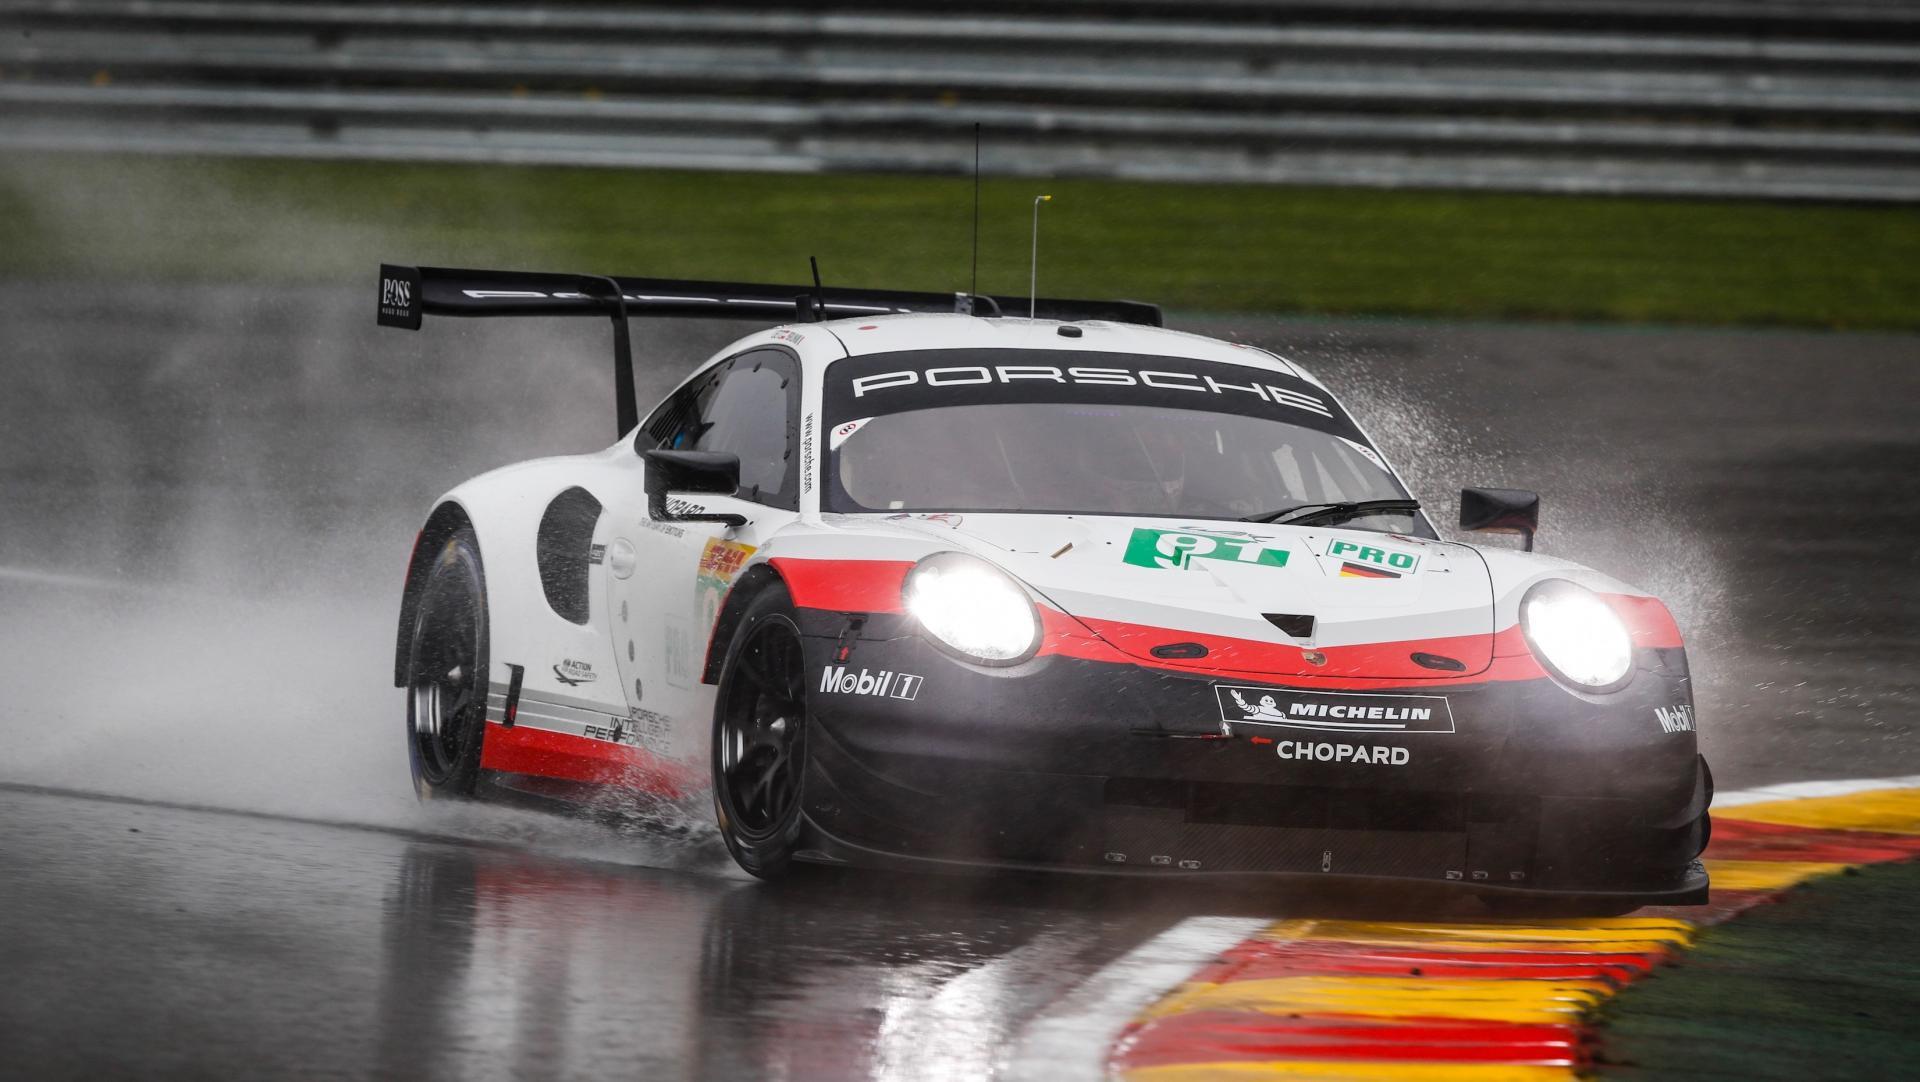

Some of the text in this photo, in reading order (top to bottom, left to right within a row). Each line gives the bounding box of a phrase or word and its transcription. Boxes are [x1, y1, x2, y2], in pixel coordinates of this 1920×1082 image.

[383, 278, 410, 307] BOSS
[852, 366, 1335, 418] PORSCHE
[802, 412, 814, 495] www.porsche.com
[1332, 541, 1414, 569] PRO
[819, 666, 893, 697] Mobil
[1289, 702, 1431, 721] MICHELIN
[1276, 740, 1410, 765] CHOPARD
